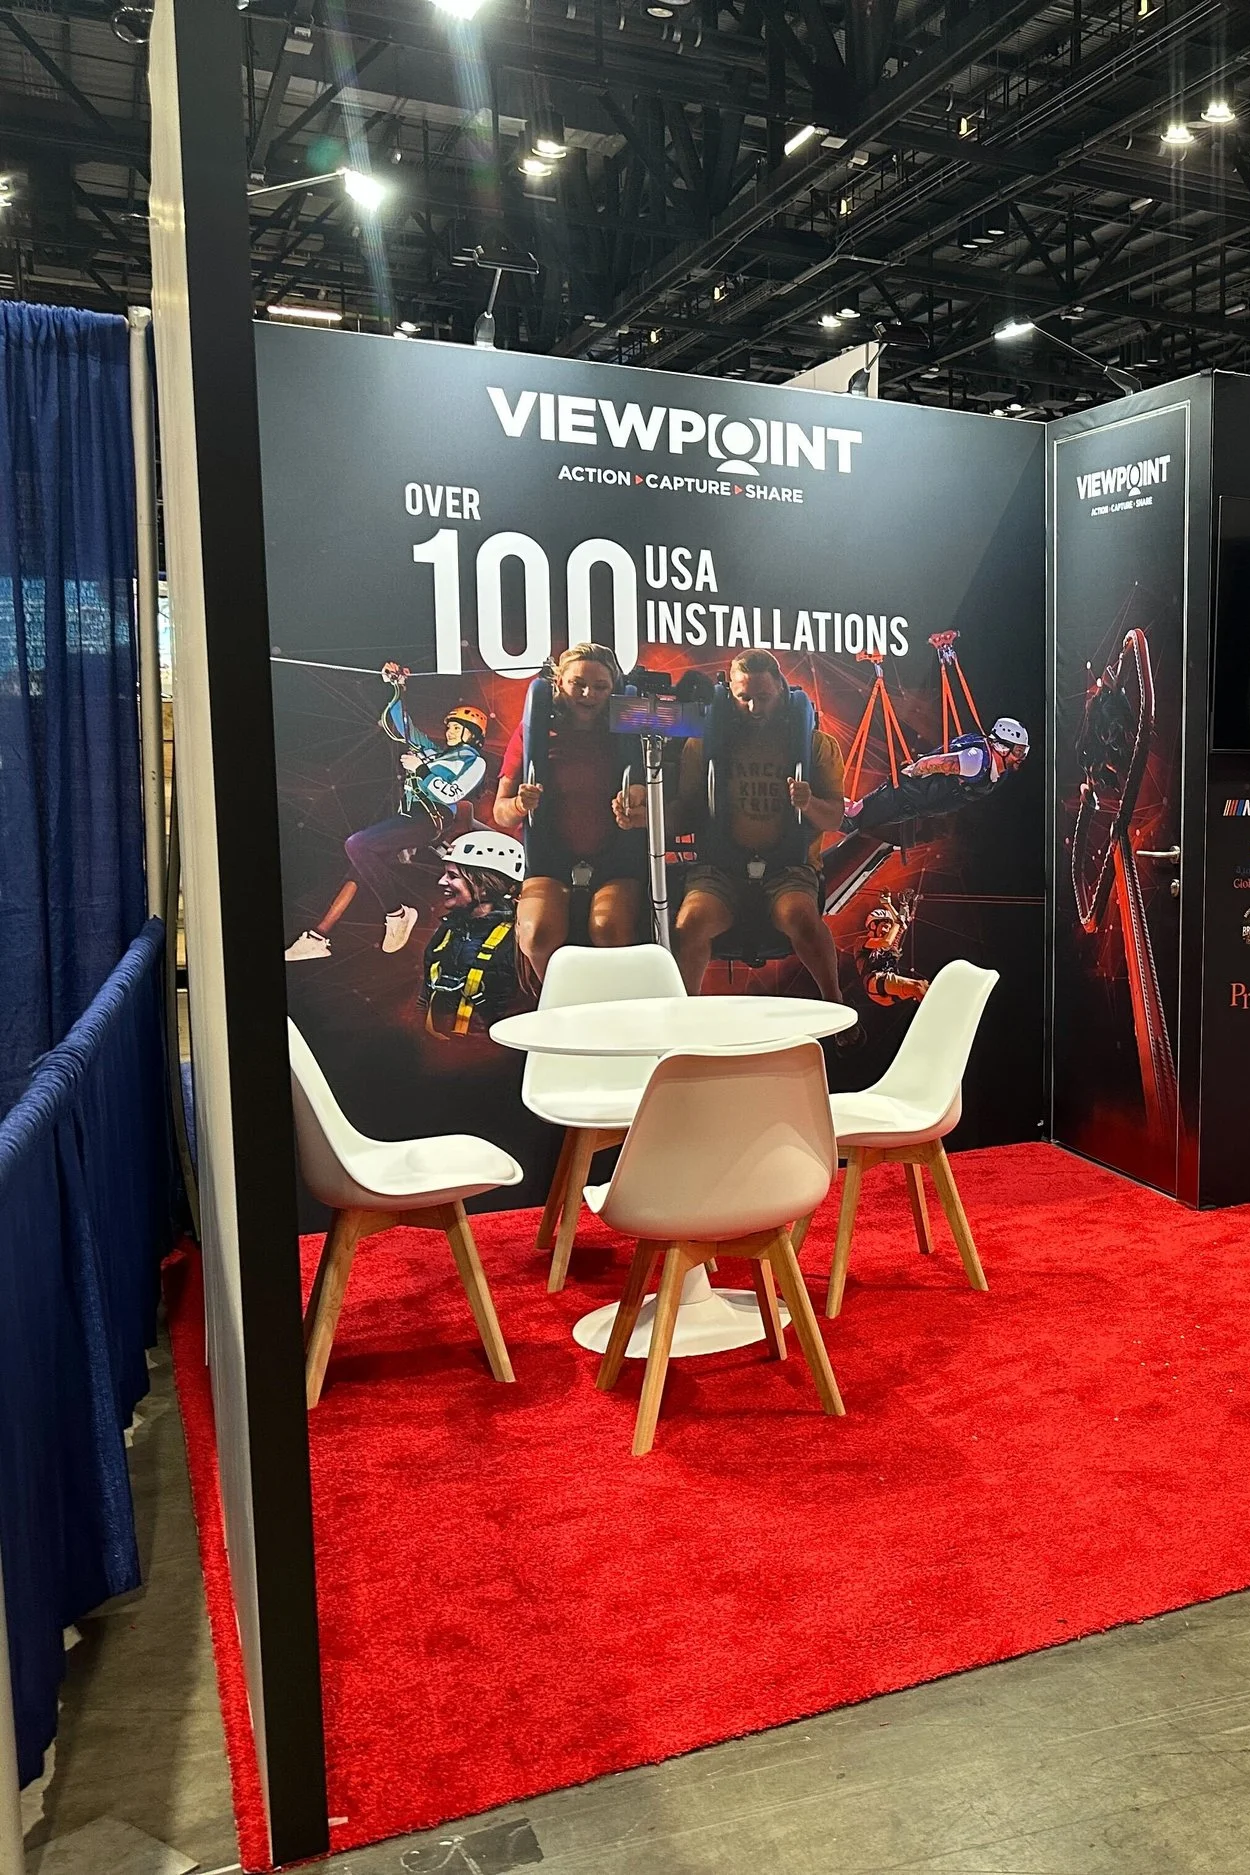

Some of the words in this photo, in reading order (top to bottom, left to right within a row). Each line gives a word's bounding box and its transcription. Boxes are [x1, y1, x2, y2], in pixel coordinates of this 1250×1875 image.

[486, 386, 864, 477] VIEWPOINT
[558, 464, 631, 487] ACTION
[645, 473, 731, 496] CAPTURE
[745, 484, 804, 504] SHARE
[1076, 454, 1171, 500] VIEWPOINT
[404, 482, 481, 521] OVER
[1091, 505, 1109, 516] ACTION
[1111, 500, 1133, 512] CAPTURE
[1136, 496, 1153, 508] SHARE
[645, 544, 718, 593] USA
[413, 528, 639, 679] 100
[646, 599, 910, 657] INSTALLATIONS
